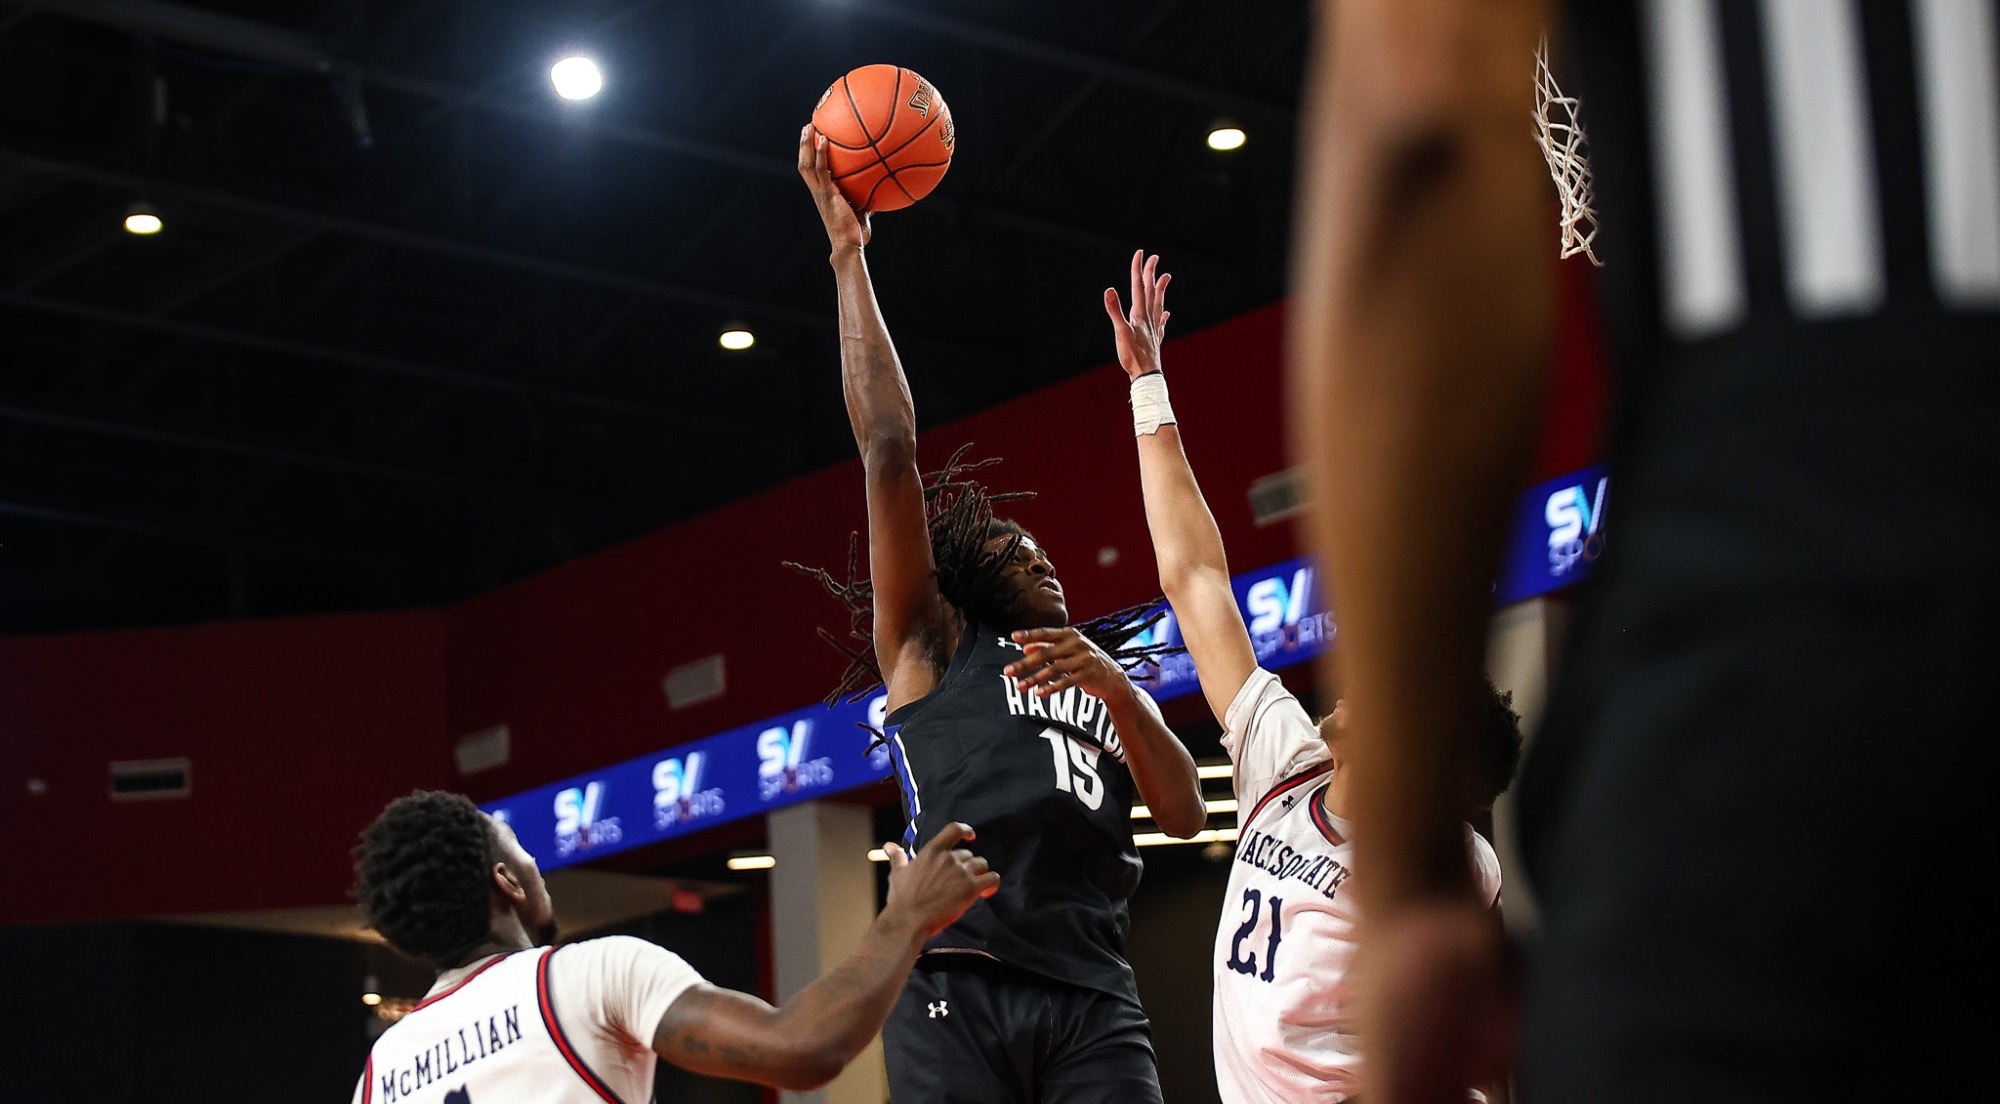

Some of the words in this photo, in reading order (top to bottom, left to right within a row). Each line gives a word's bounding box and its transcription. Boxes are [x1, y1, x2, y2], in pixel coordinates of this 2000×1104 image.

[1000, 674, 1126, 764] HAMPTO
[1039, 727, 1104, 811] 15
[1237, 829, 1310, 881] ACKSO
[1297, 855, 1351, 900] ATE
[1226, 887, 1283, 983] 21
[381, 1004, 523, 1104] McMILLIAN
